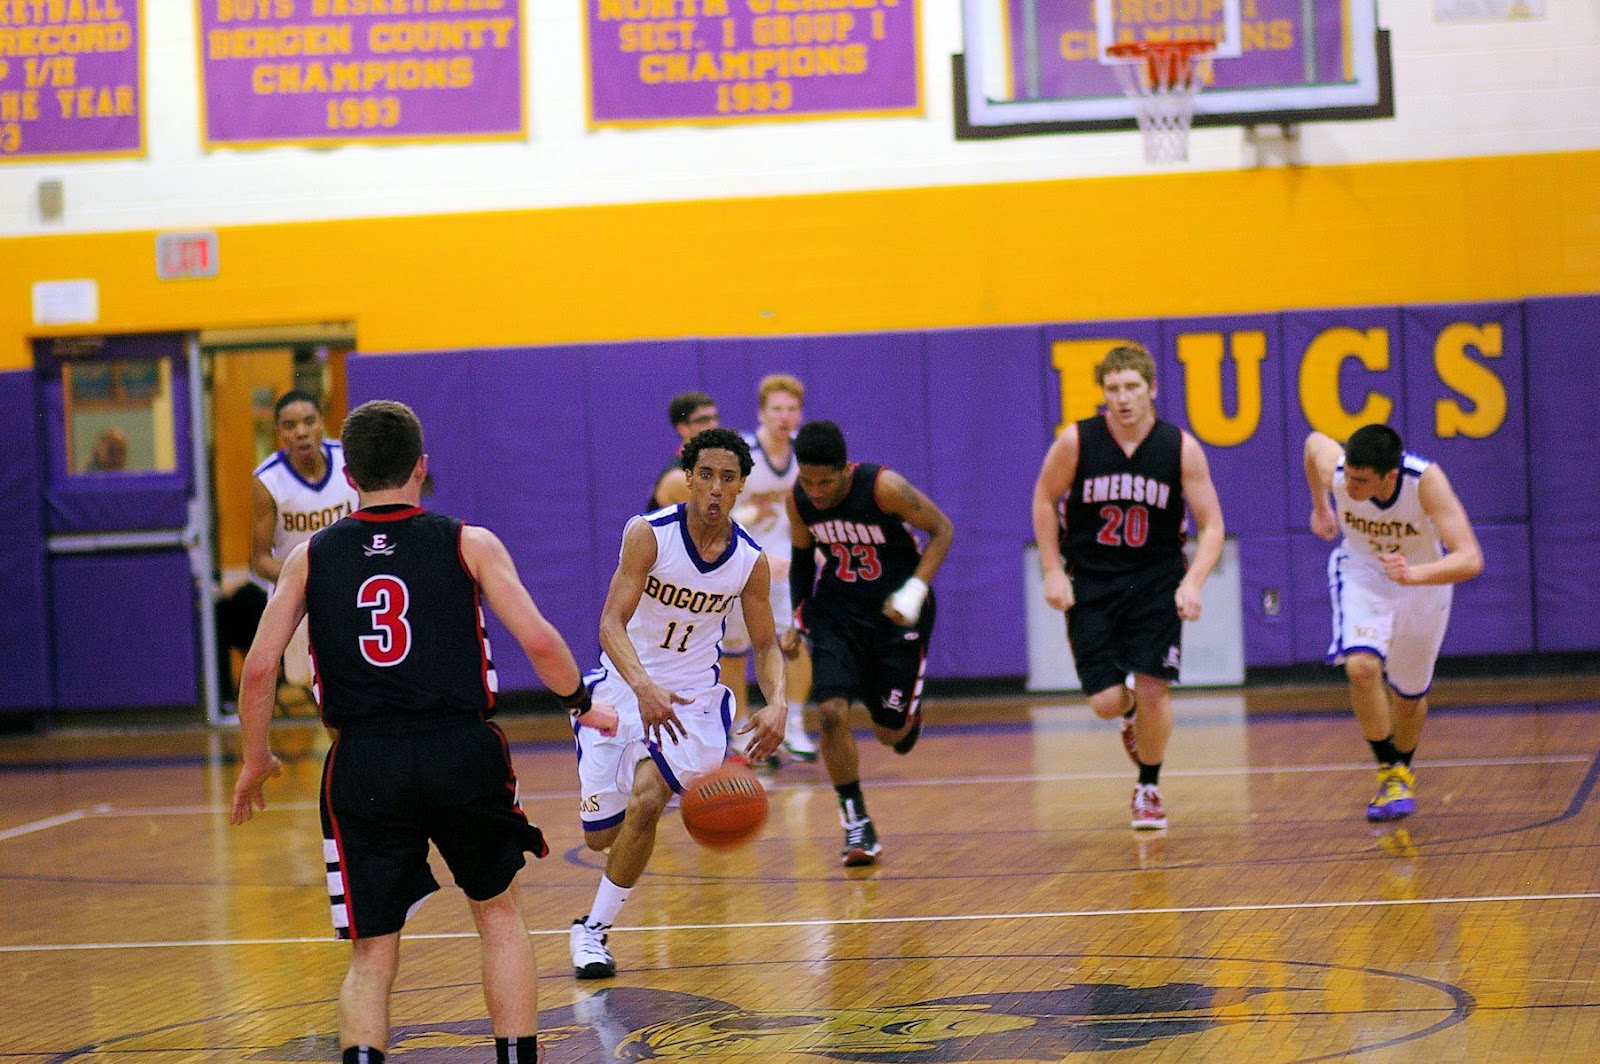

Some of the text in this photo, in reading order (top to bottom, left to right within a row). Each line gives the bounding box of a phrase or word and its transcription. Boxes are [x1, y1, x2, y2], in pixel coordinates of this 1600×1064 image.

[1092, 0, 1221, 23] ROUP
[0, 22, 130, 55] RECORD
[209, 19, 514, 59] BERGEN COUNTY
[620, 22, 704, 51] SECT.
[753, 16, 853, 46] GROUP
[252, 58, 473, 94] CHAMPIONS
[639, 44, 867, 83] CHAMPIONS
[58, 86, 133, 119] YEAR
[327, 98, 400, 128] 1993
[716, 80, 792, 112] 1993
[1083, 473, 1170, 509] EMERSON
[372, 534, 388, 549] E
[1097, 505, 1149, 548] 20
[830, 542, 882, 582] 23
[357, 574, 412, 667] 3
[660, 621, 694, 653] 11
